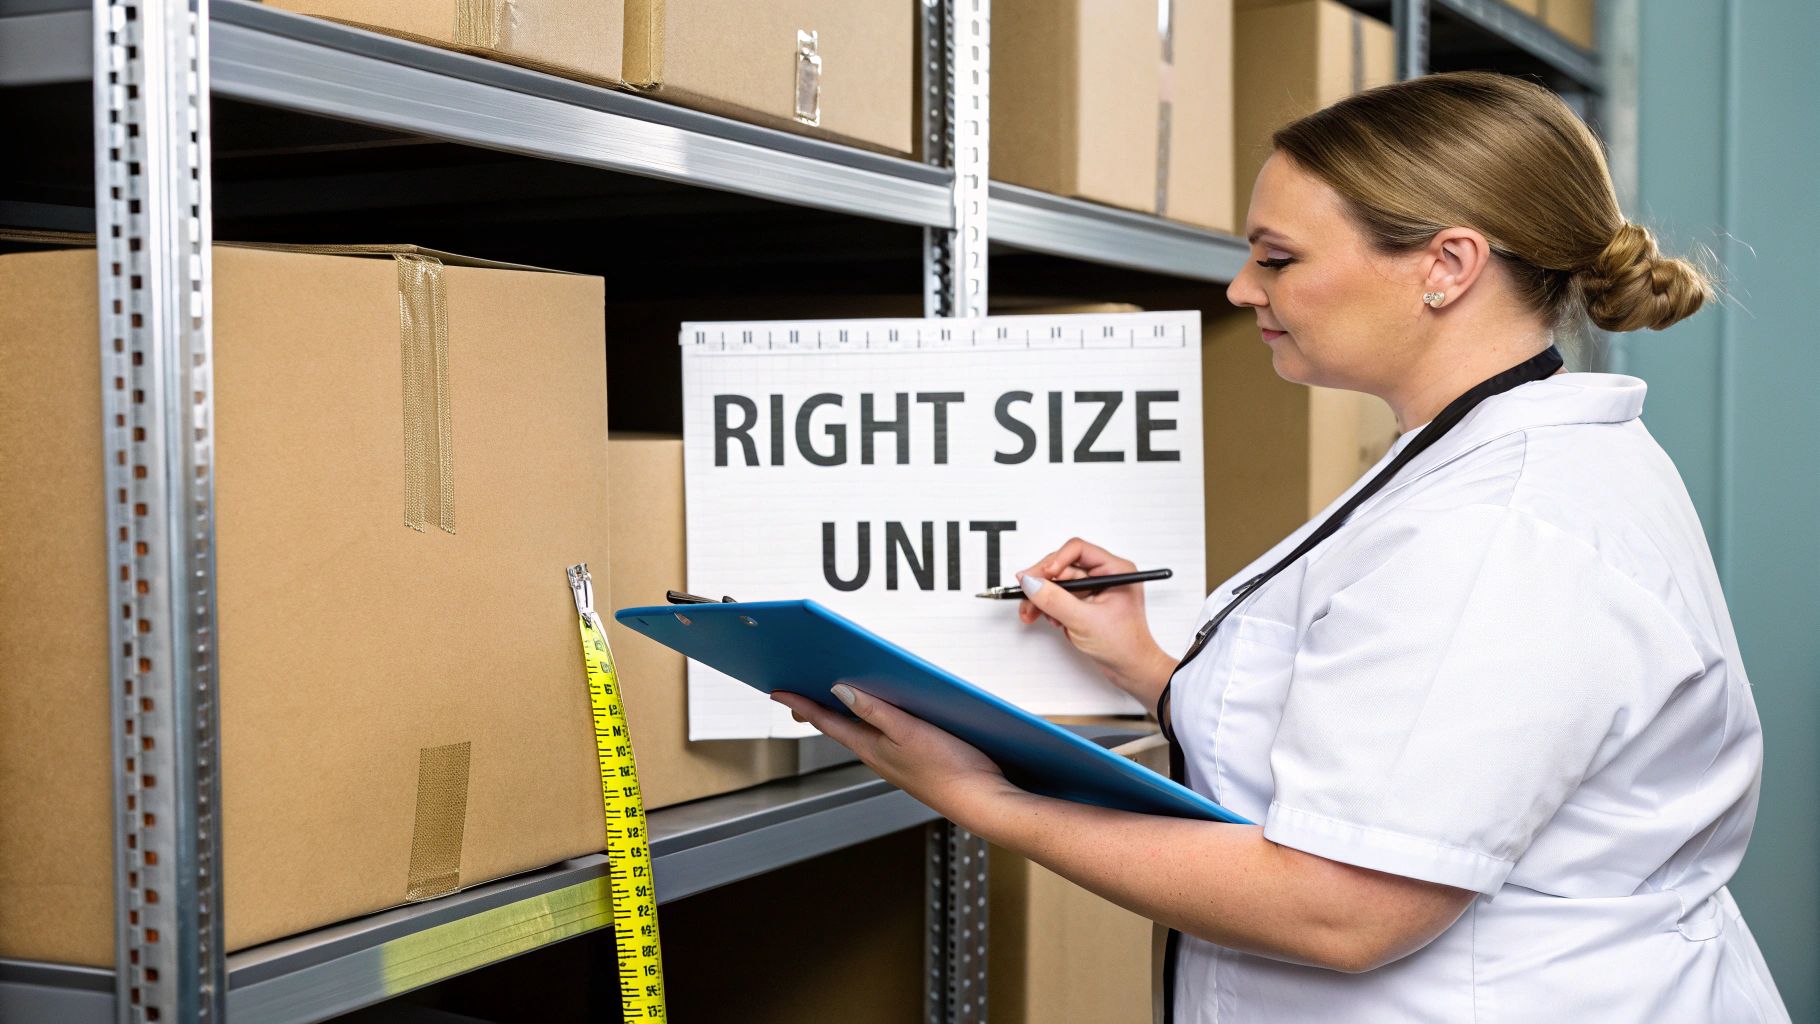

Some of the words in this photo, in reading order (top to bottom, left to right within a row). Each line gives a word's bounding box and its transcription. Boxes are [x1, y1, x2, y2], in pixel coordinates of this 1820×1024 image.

[714, 391, 965, 467] RIGHT
[994, 390, 1181, 465] SIZE
[821, 520, 1017, 592] UNIT
